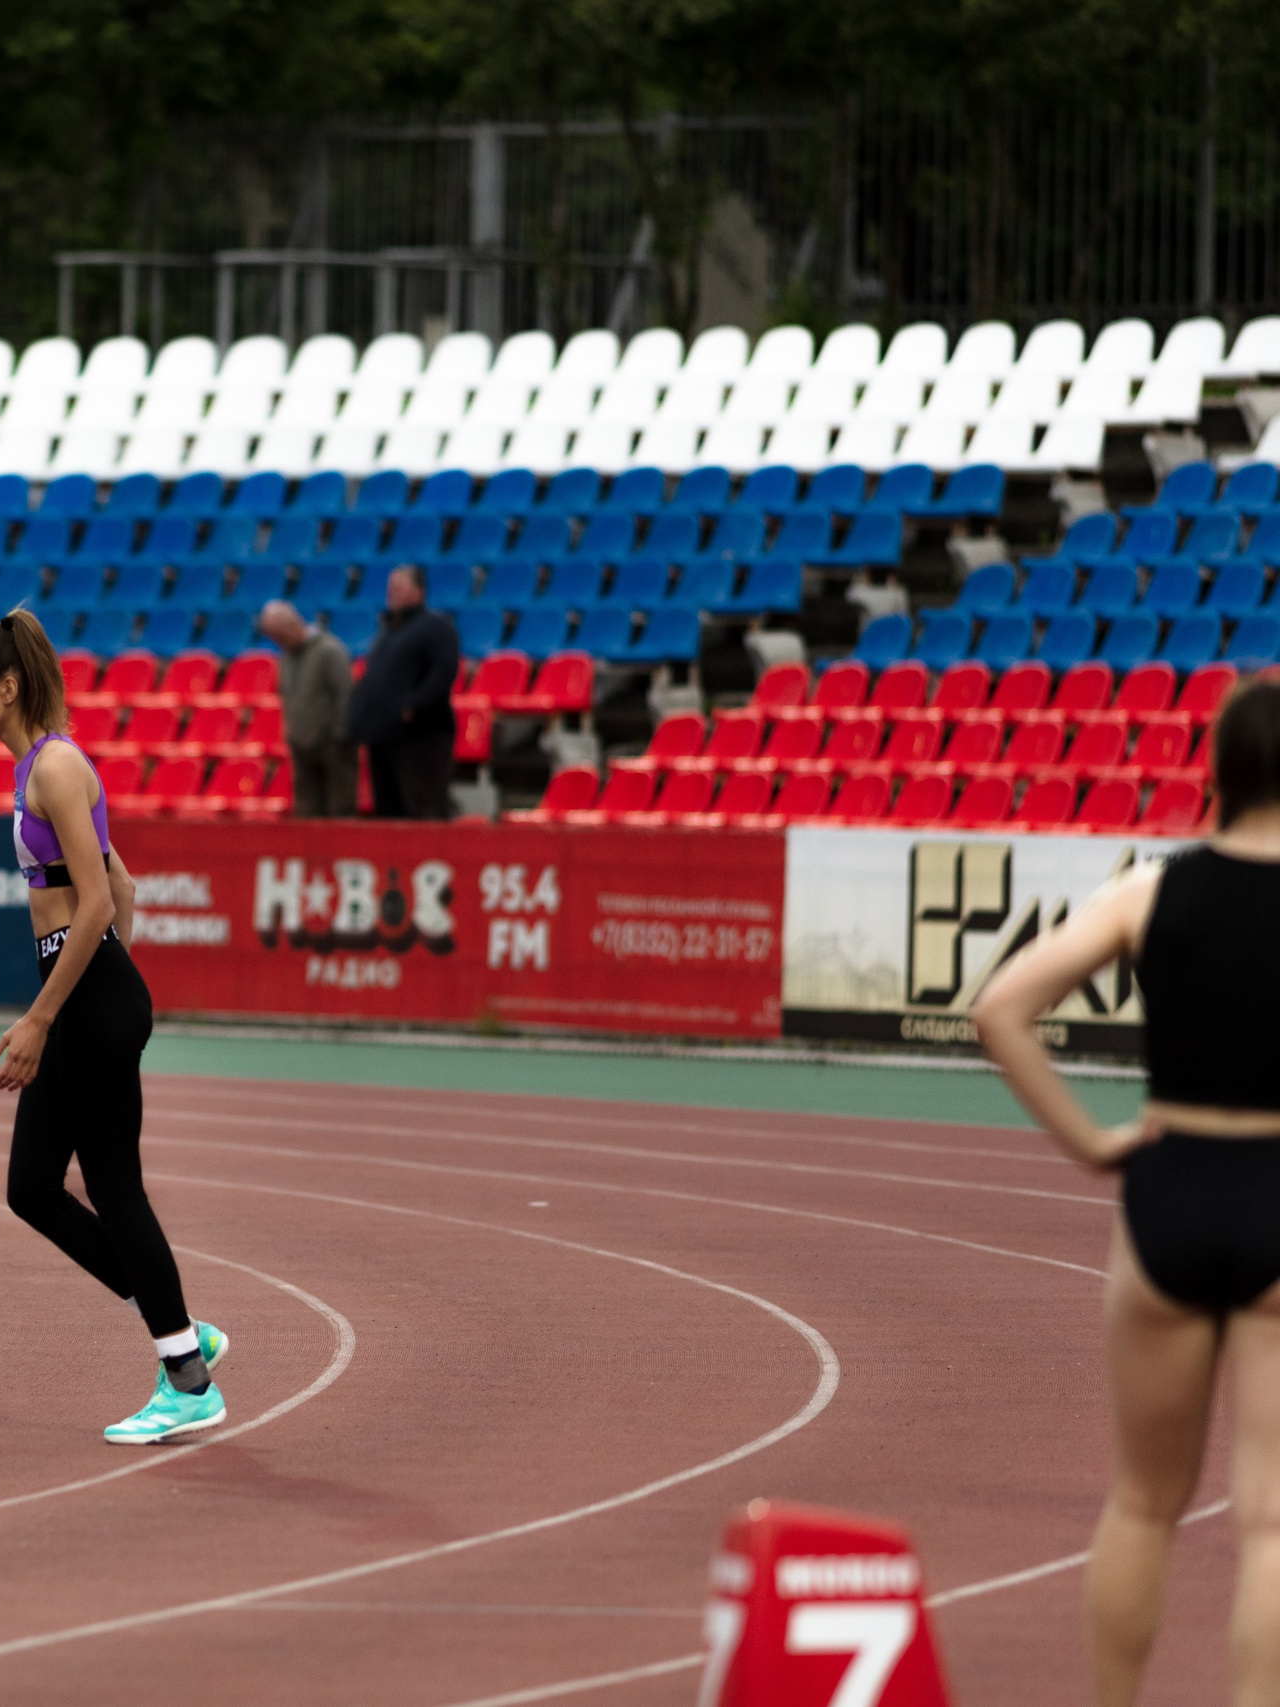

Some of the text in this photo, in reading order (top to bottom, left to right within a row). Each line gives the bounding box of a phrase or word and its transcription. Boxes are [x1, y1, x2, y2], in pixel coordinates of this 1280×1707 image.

[478, 863, 562, 915] 95.4
[305, 953, 402, 989] РАДИО
[486, 916, 551, 973] FM
[784, 1600, 920, 1707] 7
